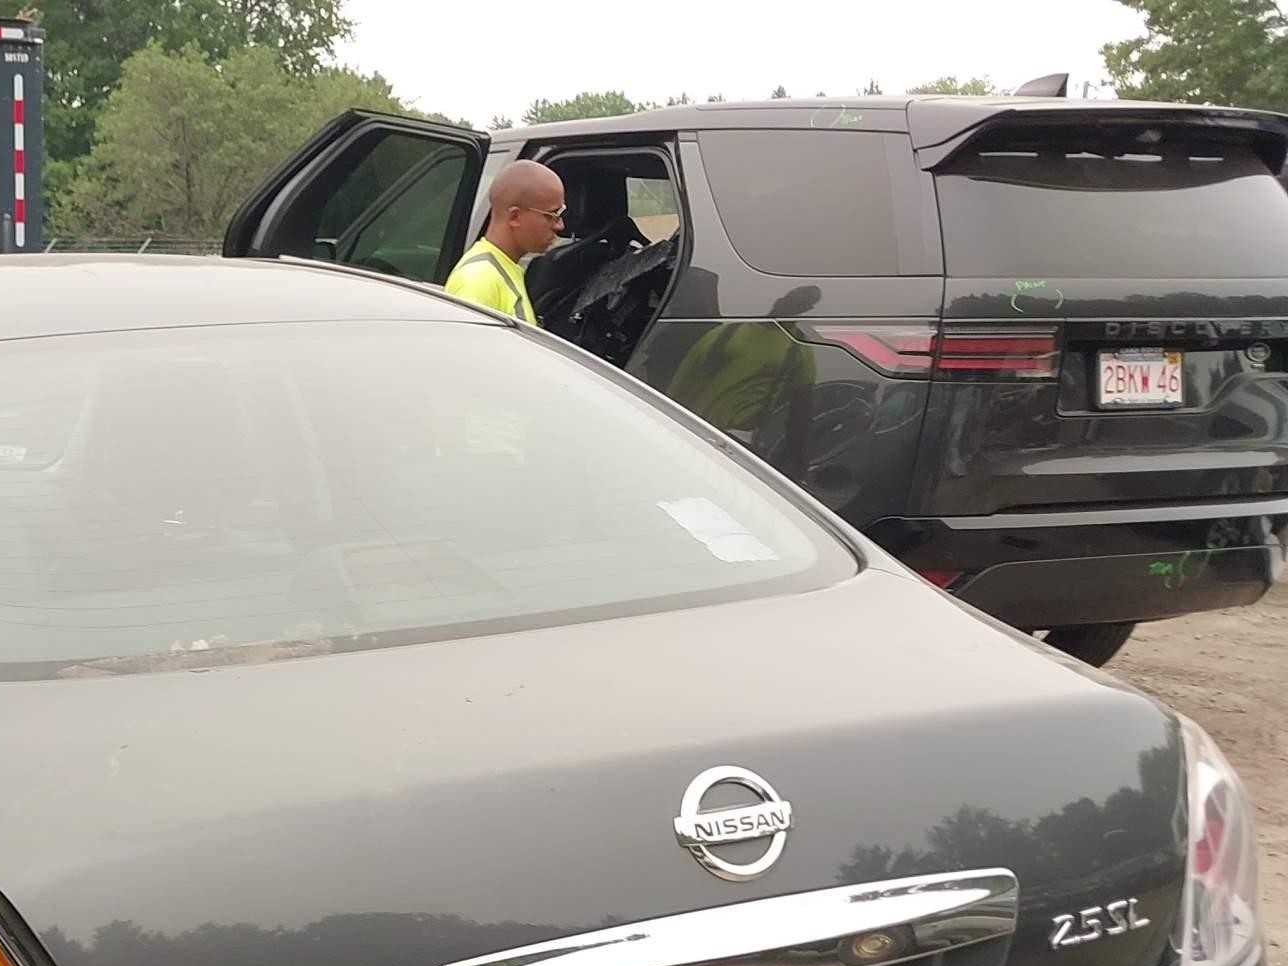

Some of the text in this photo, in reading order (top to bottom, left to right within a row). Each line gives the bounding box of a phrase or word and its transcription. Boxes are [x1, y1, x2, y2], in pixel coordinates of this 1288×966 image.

[1104, 364, 1180, 394] 2BKW 46
[694, 809, 785, 838] NISSAN
